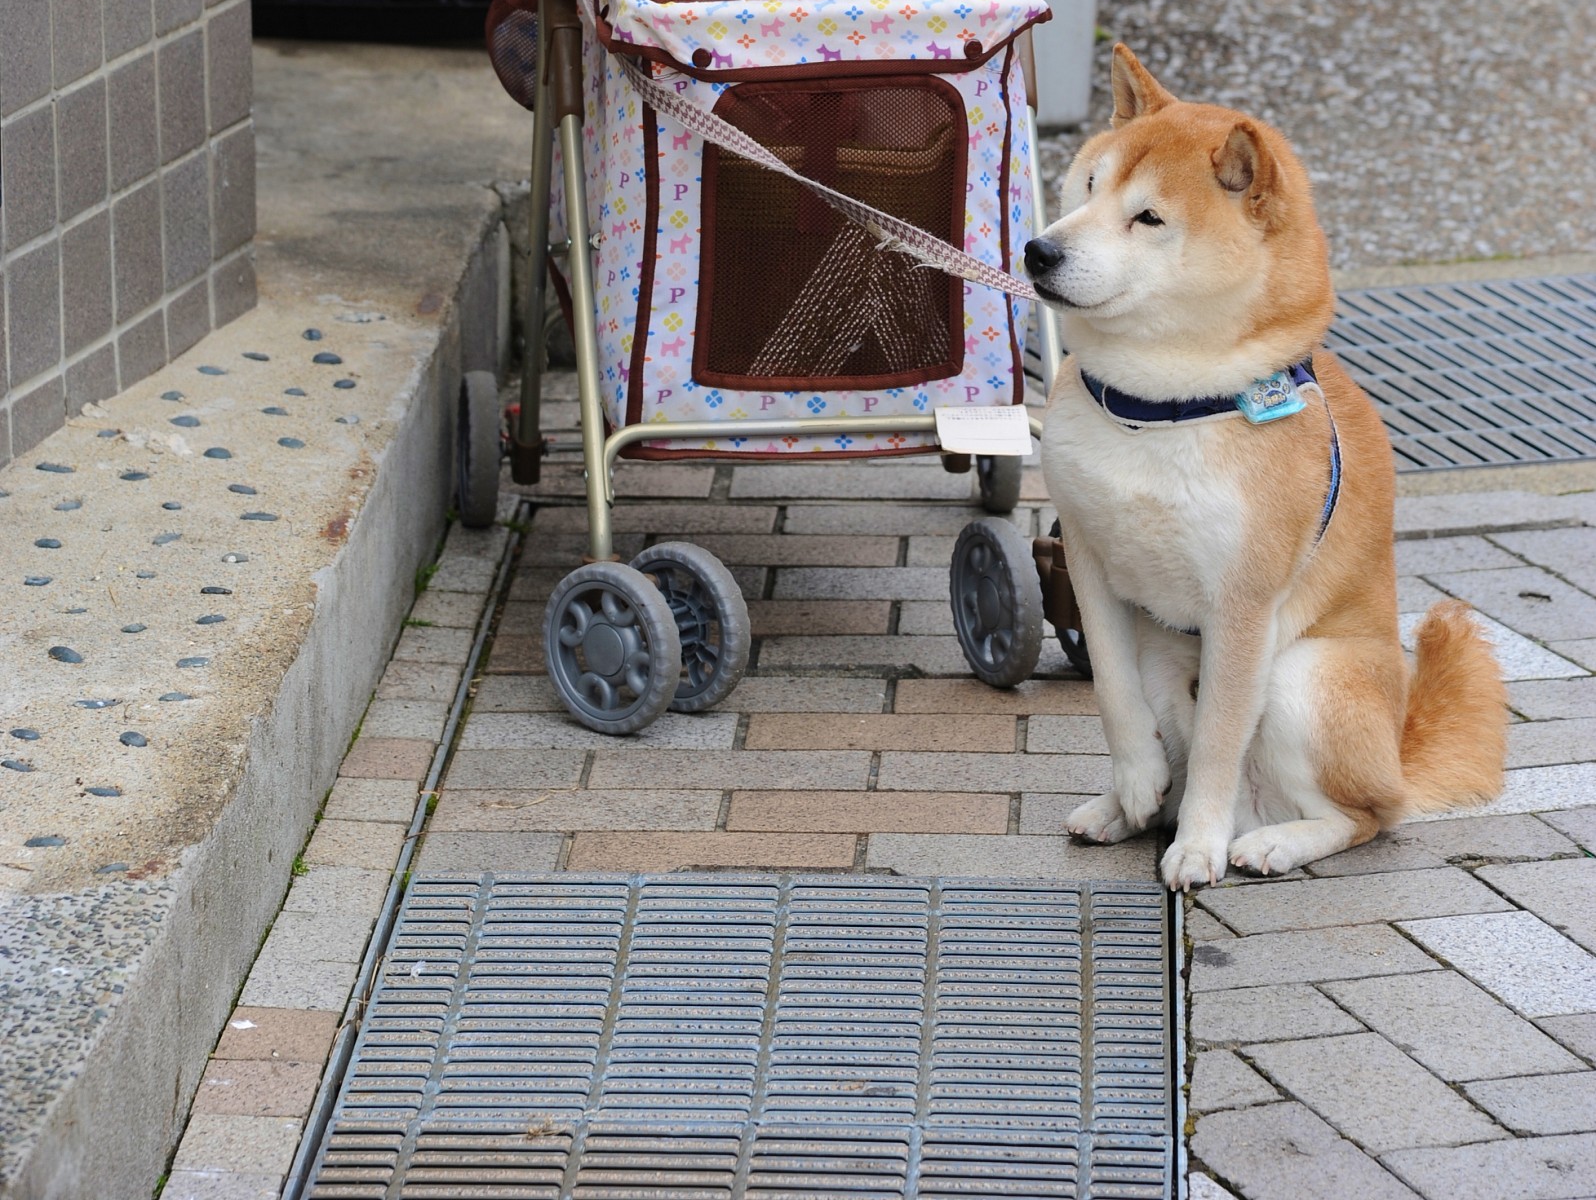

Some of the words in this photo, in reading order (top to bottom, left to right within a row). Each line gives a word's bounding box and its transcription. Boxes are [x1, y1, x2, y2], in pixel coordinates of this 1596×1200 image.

[975, 80, 988, 97] P
[673, 184, 688, 201] P
[669, 287, 685, 304] P
[655, 389, 672, 404] P
[964, 386, 980, 402] P
[759, 395, 776, 411] P
[863, 397, 879, 412] P
